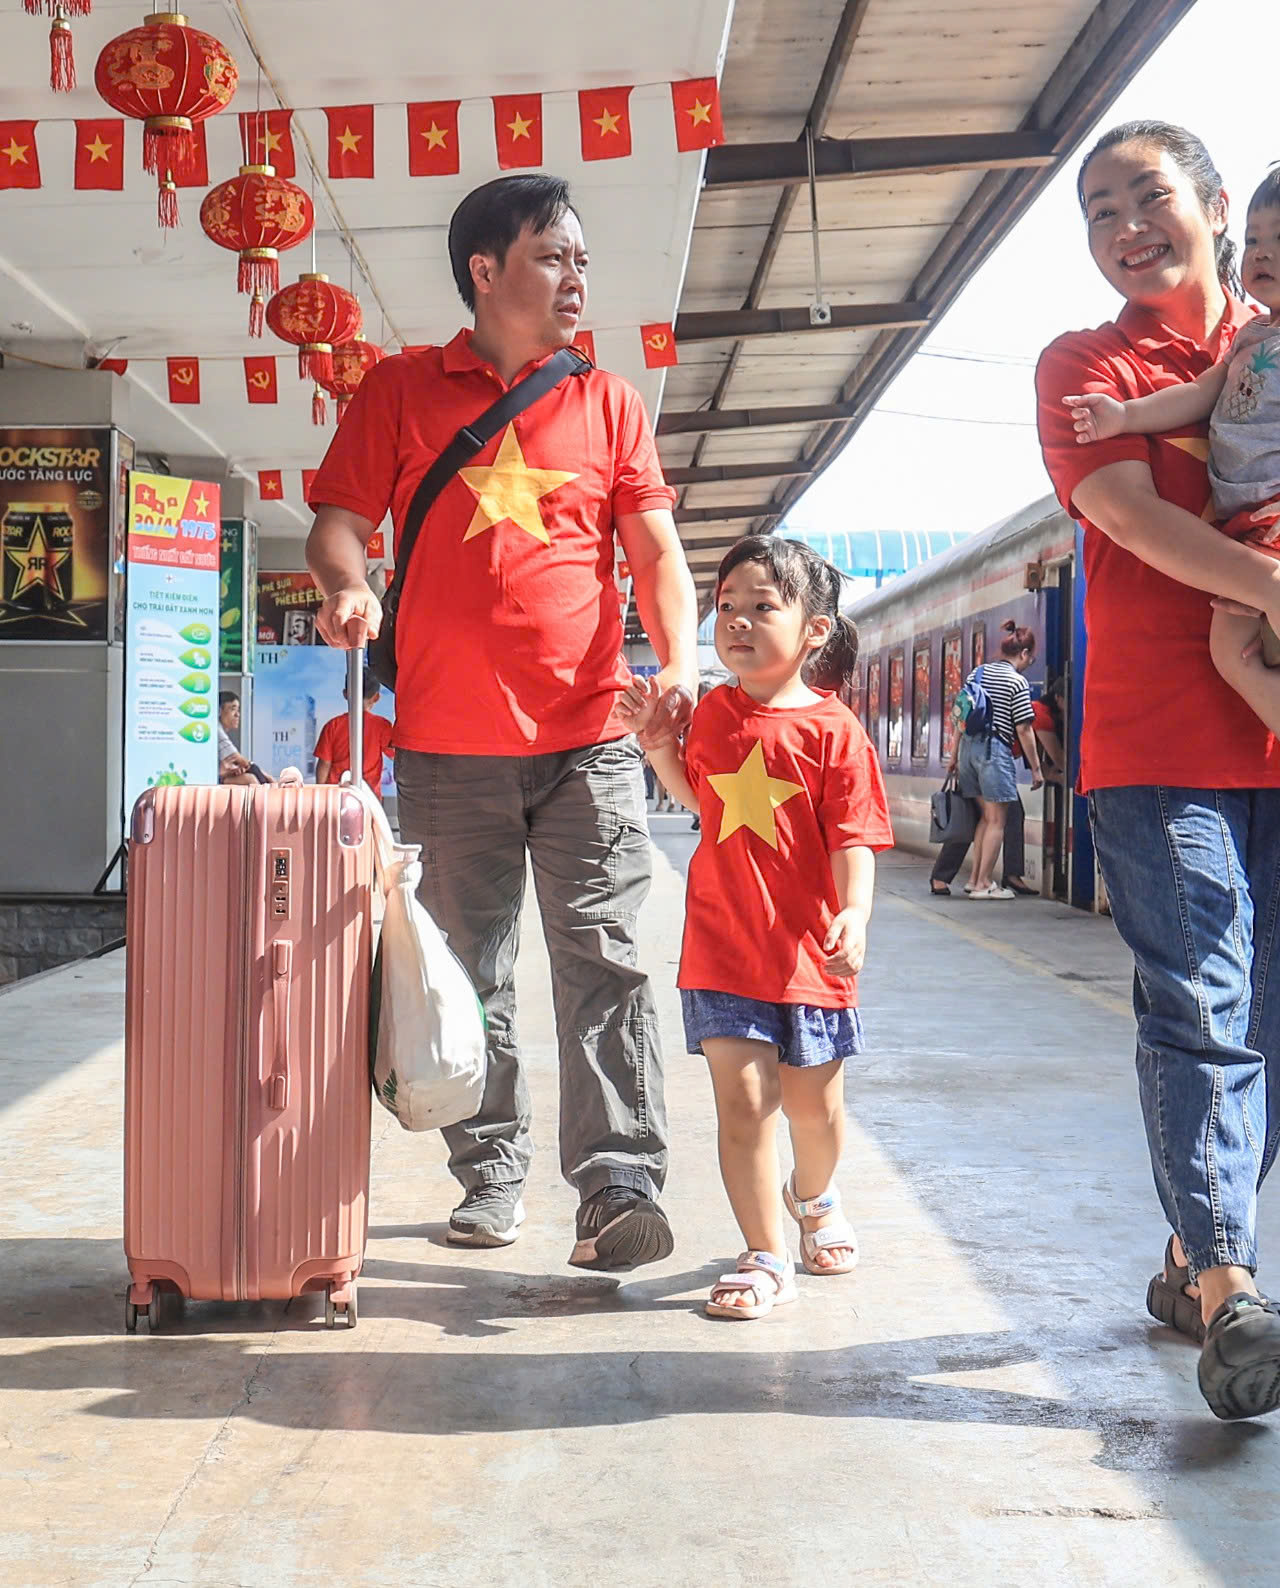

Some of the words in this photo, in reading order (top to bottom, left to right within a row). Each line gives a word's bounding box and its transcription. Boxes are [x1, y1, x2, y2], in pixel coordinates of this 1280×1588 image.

[0, 447, 100, 467] OCKSTAR
[0, 467, 26, 480] ƯỚC
[29, 468, 63, 480] TĂNG
[67, 469, 93, 484] LỰC
[259, 652, 278, 664] TH
[273, 731, 289, 741] TH
